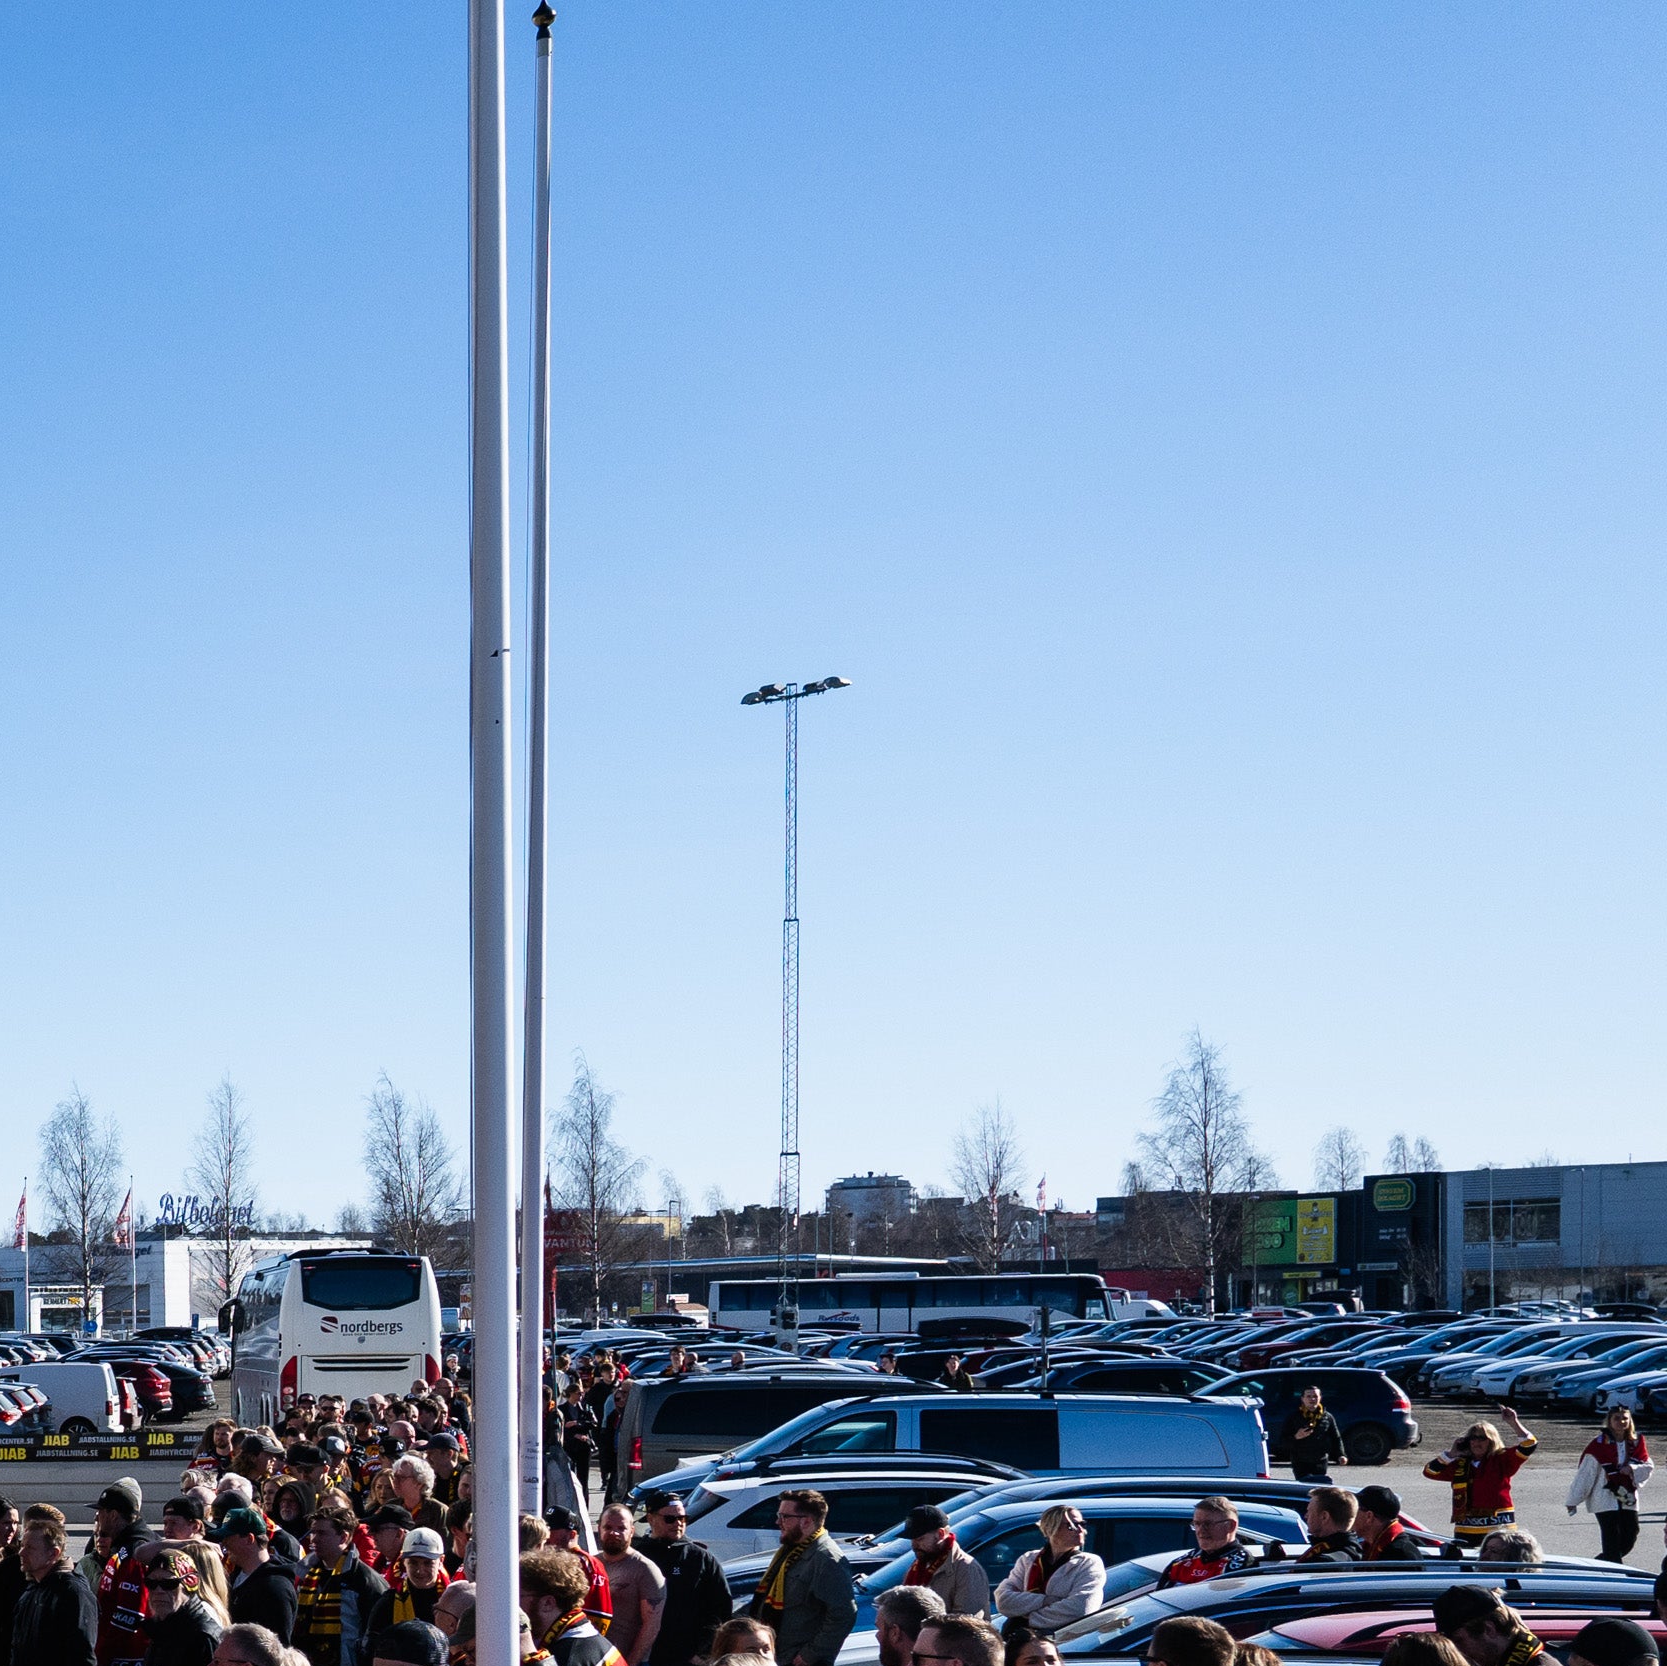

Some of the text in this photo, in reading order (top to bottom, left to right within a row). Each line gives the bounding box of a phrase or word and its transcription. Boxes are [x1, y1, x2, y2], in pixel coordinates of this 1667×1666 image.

[340, 1320, 403, 1335] nordbergs
[43, 1434, 70, 1446] JIAB
[147, 1433, 174, 1445] JIAB
[110, 1446, 140, 1459] JIAB
[149, 1448, 195, 1456] JIABHYRCENT
